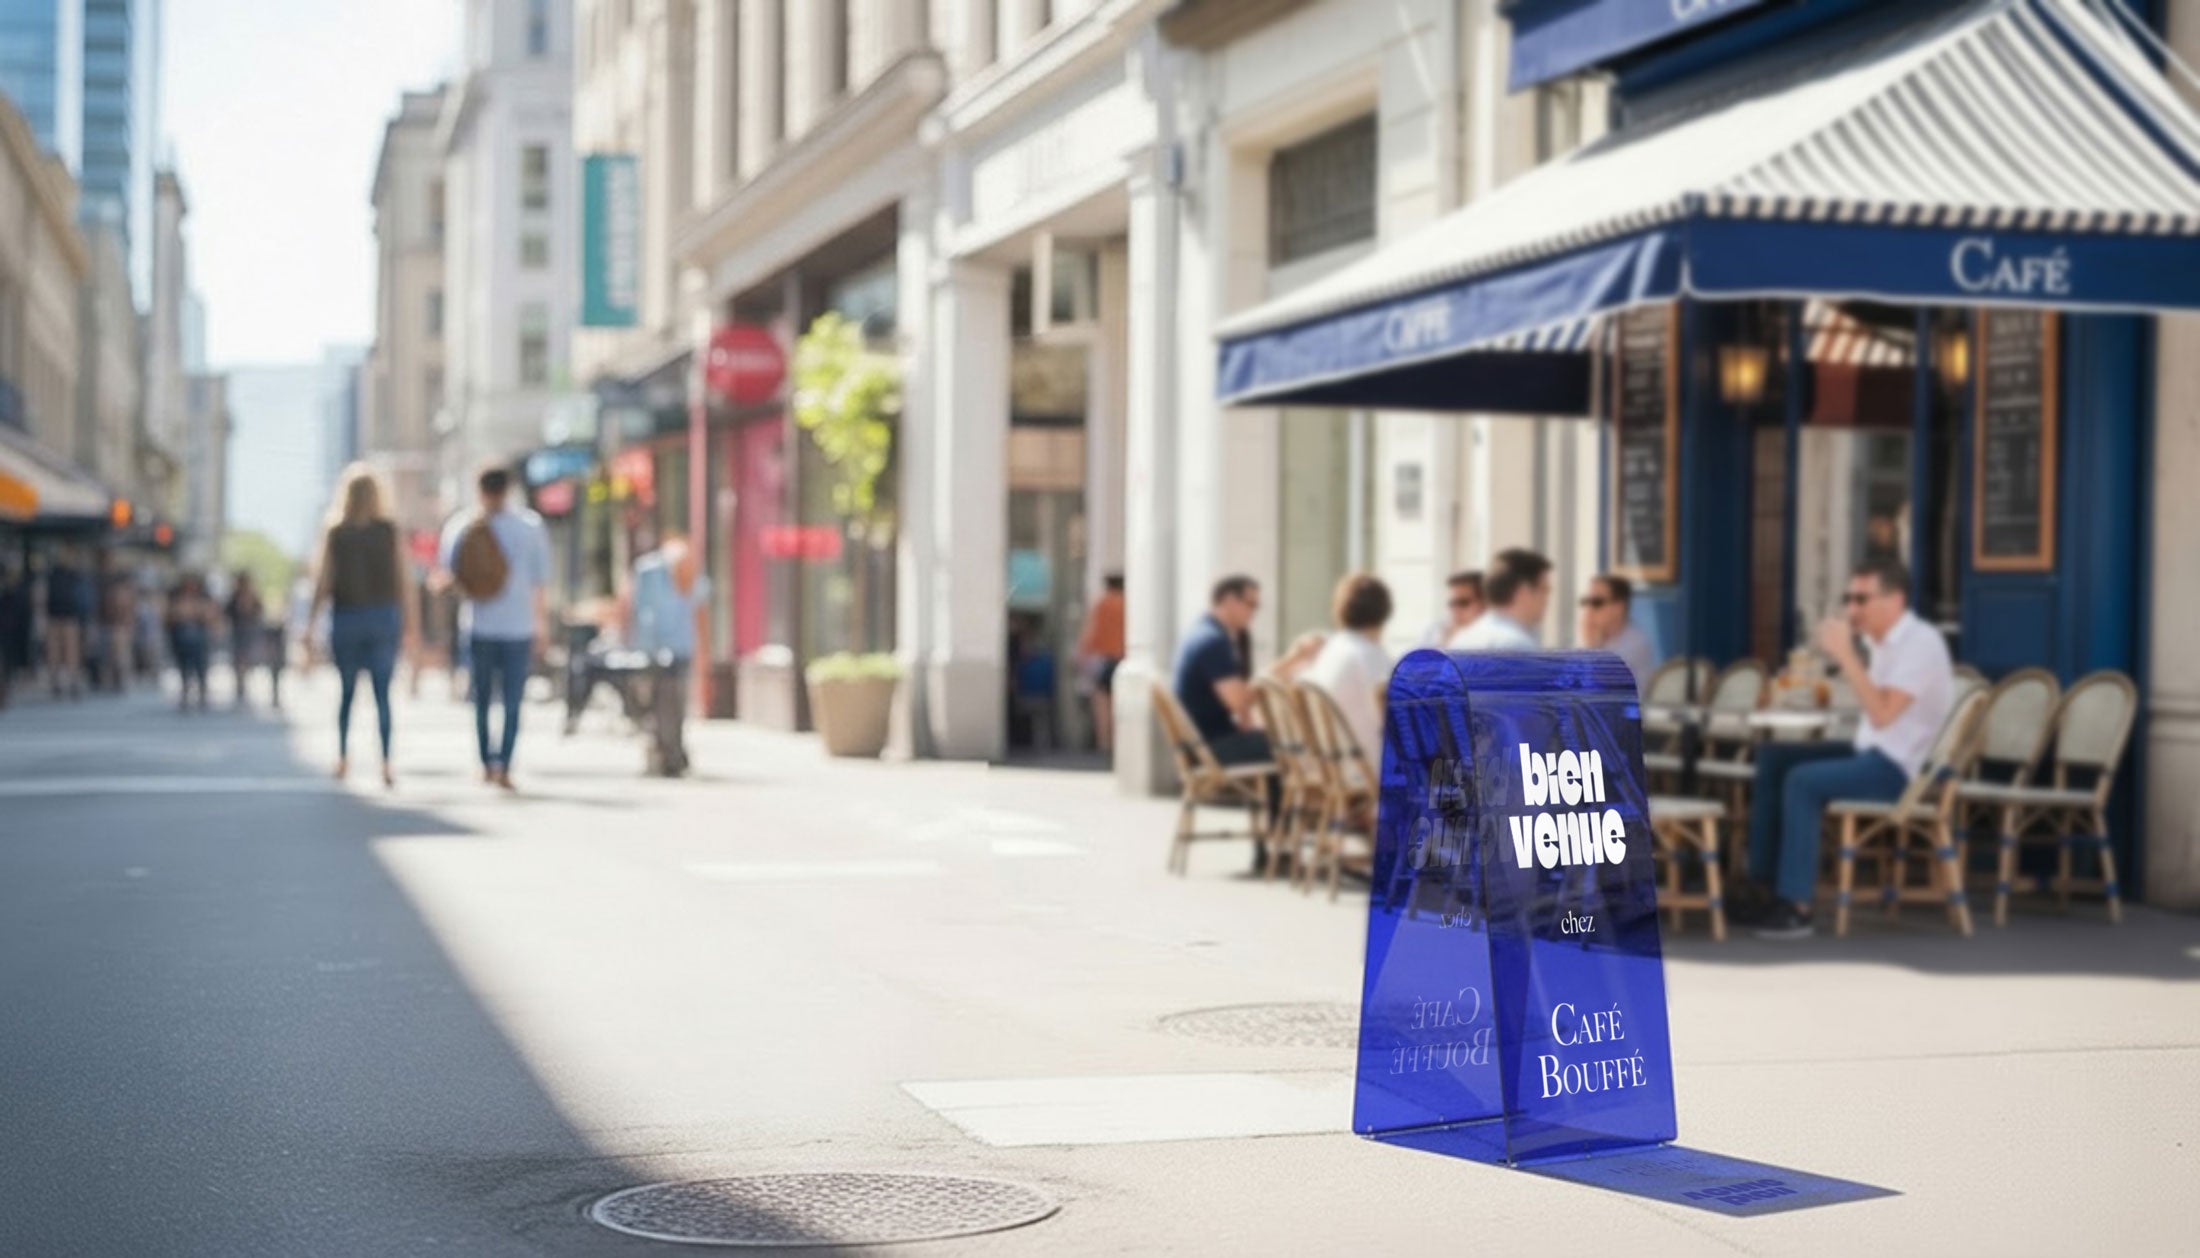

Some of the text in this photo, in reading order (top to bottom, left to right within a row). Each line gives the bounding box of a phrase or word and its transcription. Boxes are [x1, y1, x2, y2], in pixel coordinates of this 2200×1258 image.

[1519, 743, 1605, 806] bien
[1509, 809, 1626, 869] venue
[1561, 910, 1595, 934] chez
[1551, 1002, 1624, 1046] CAFÉ
[1537, 1048, 1646, 1098] BOUFFÉ
